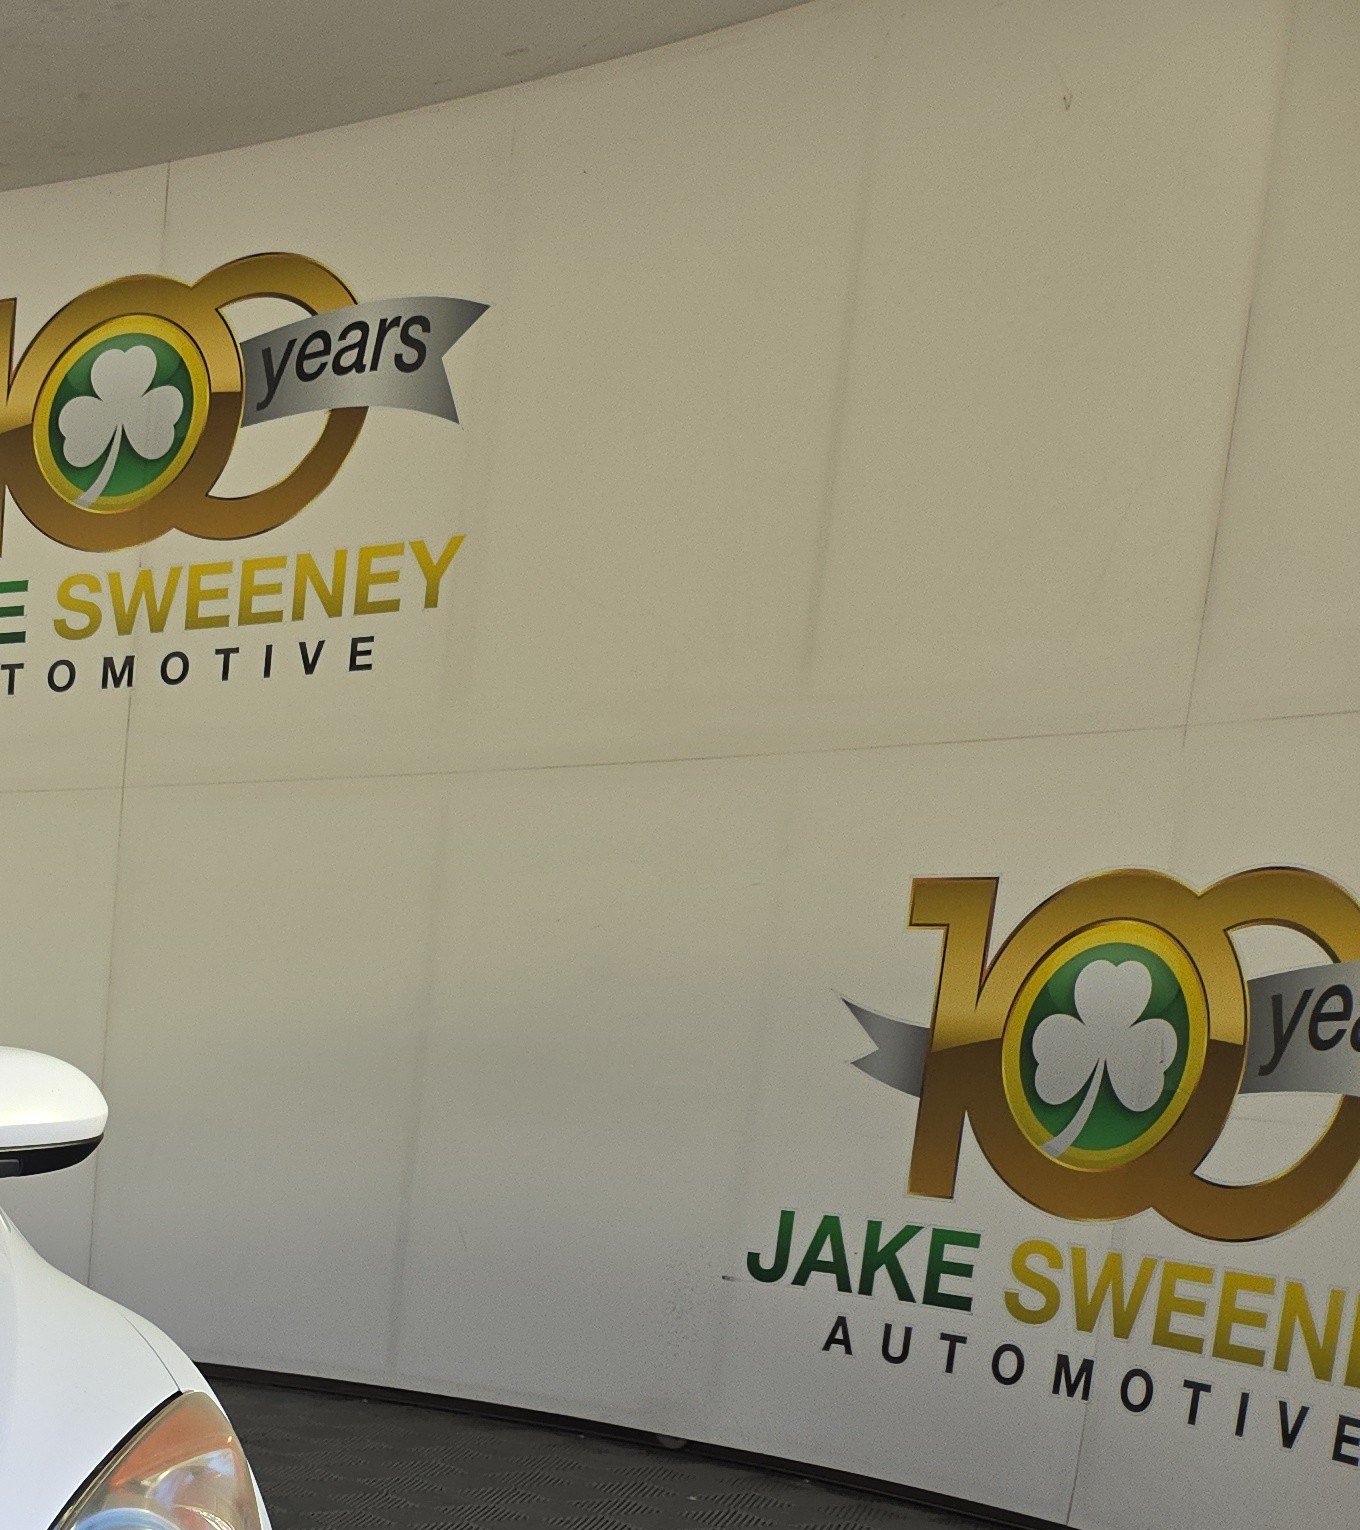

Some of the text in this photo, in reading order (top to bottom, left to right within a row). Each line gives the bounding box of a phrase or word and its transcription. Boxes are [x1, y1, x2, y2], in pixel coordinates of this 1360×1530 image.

[256, 312, 432, 412] years
[53, 534, 467, 642] SWEENEY
[1258, 984, 1360, 1077] ye
[746, 1209, 982, 1314] JAKE
[821, 1315, 1360, 1467] AUTOMOTIVE
